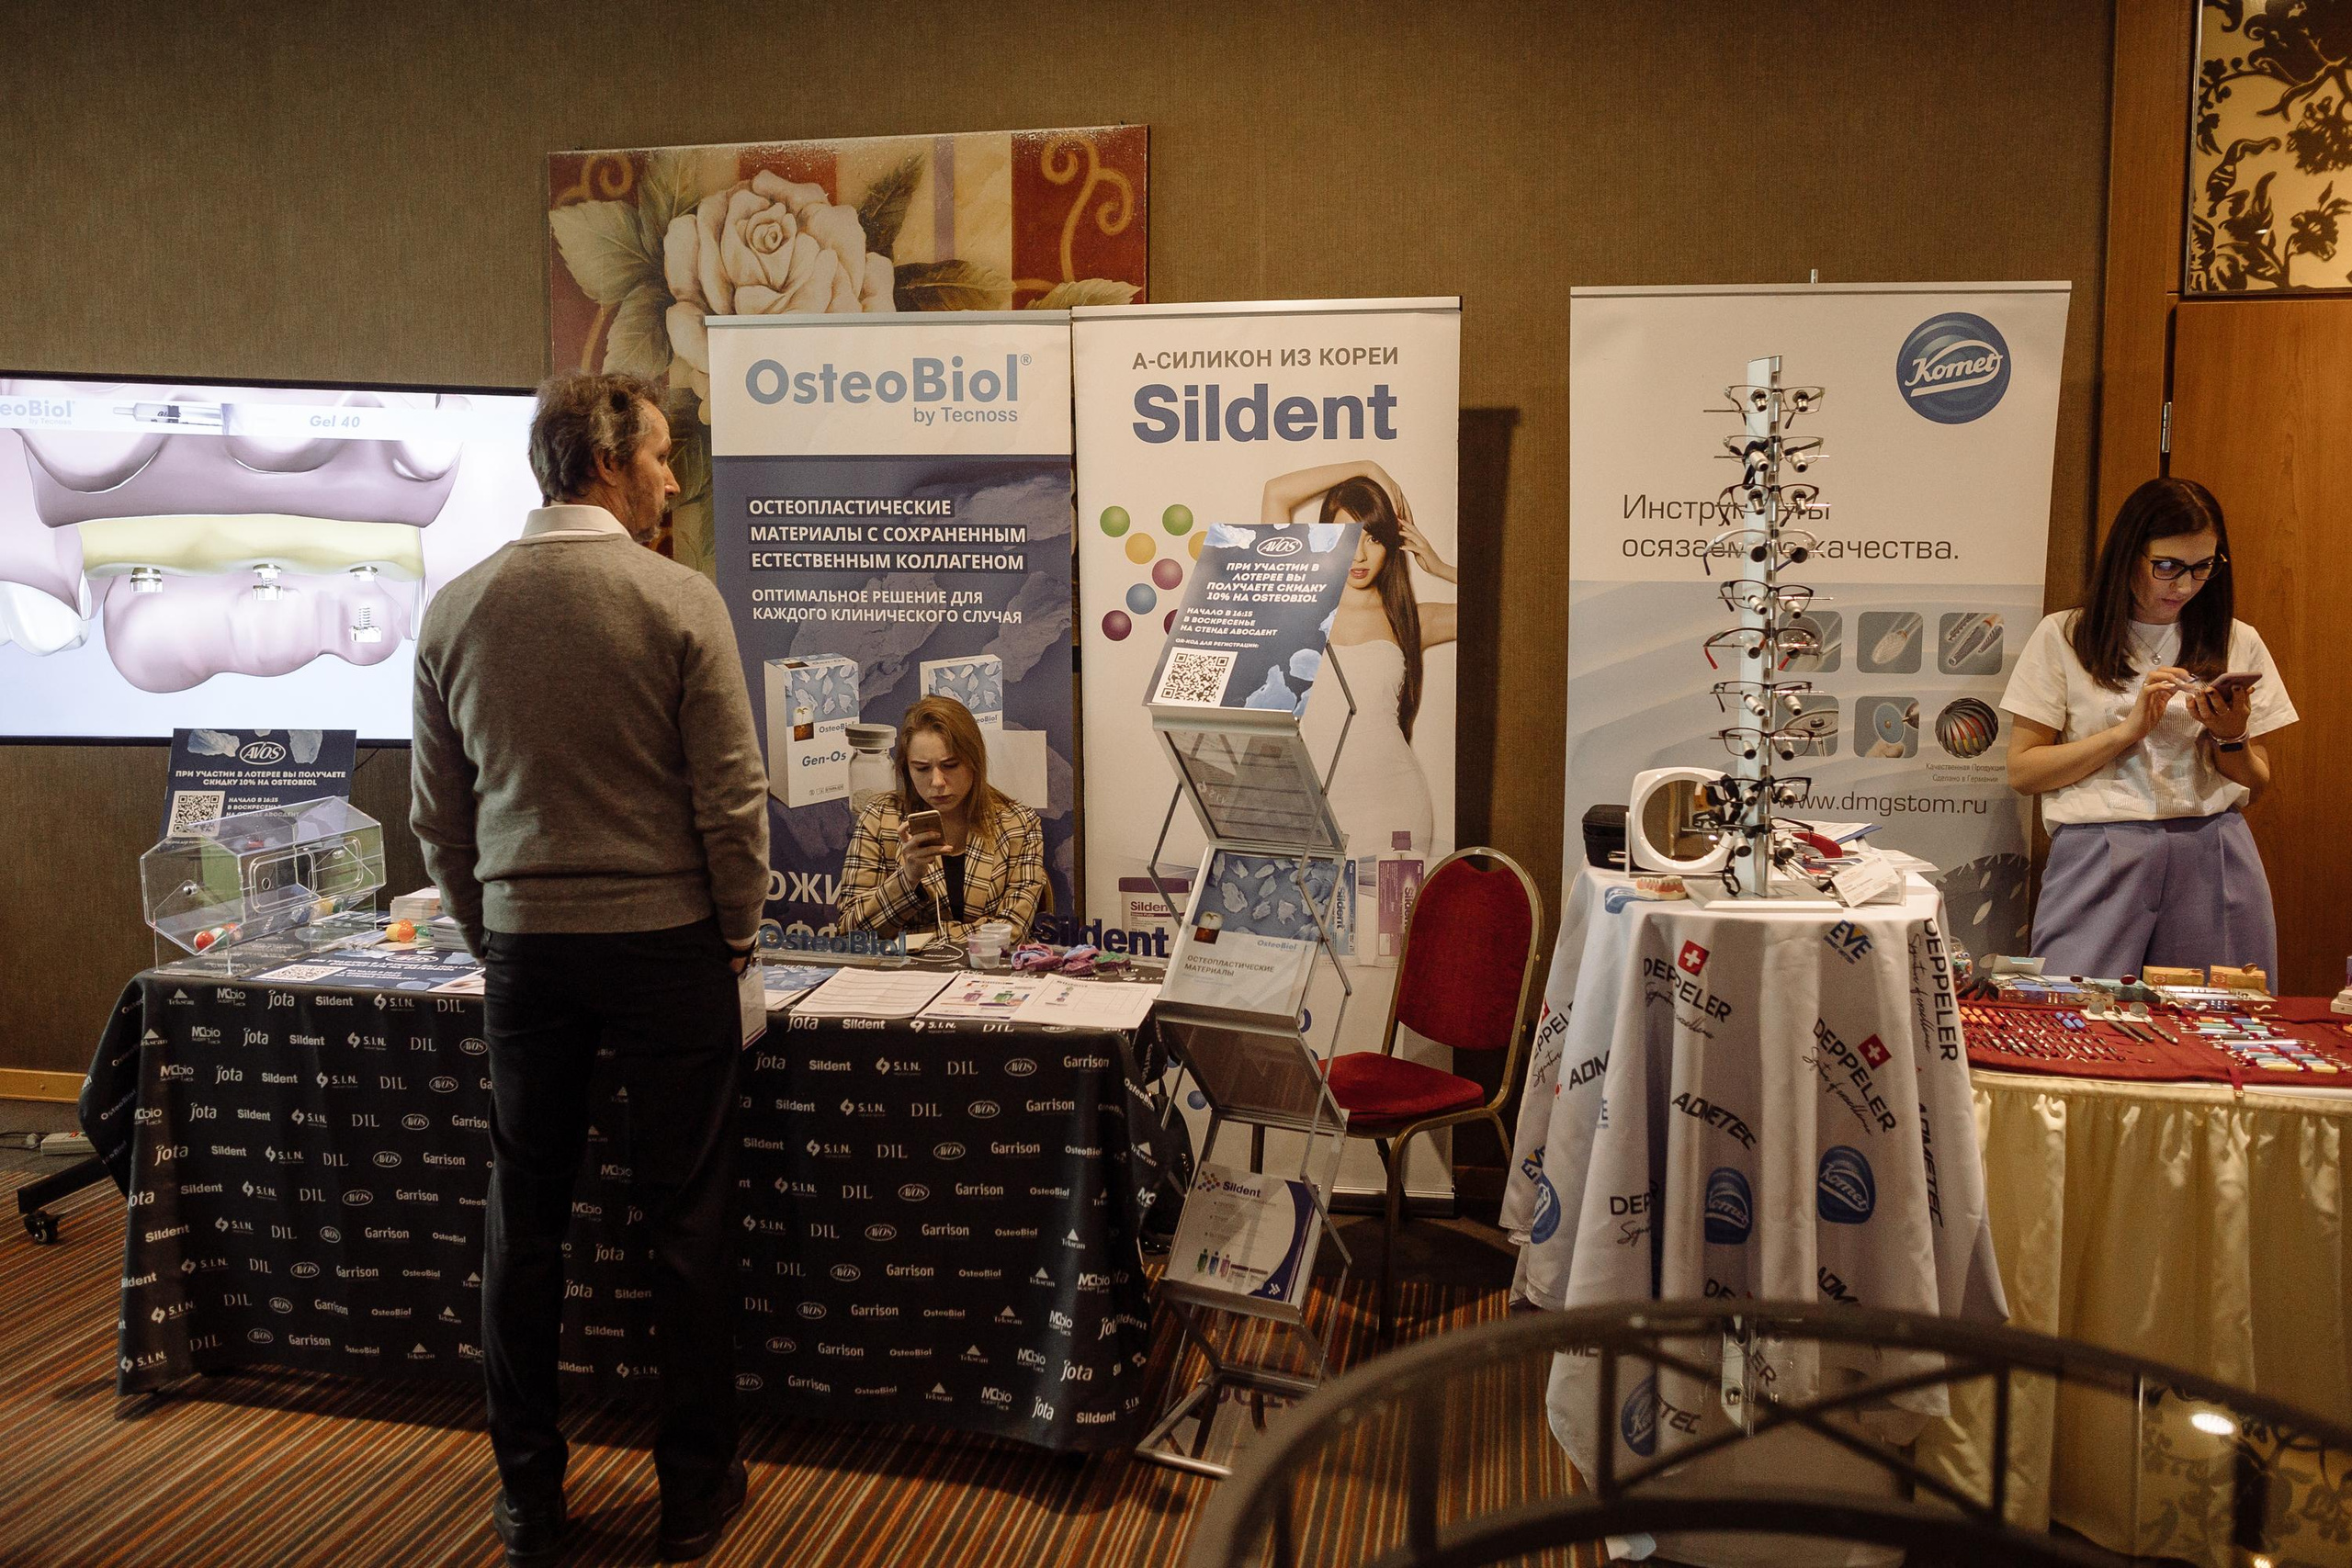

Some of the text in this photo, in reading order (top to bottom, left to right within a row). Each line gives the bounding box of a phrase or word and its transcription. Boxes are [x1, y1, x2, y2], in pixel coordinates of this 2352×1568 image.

[1133, 347, 1398, 370] А-СИЛИКОН ИЗ КОРЕИ
[1904, 340, 2003, 387] Komet
[913, 407, 1017, 426] by Tecnoss
[1133, 383, 1397, 444] Sildent
[310, 415, 360, 428] Gel 40
[750, 501, 951, 515] ОСТЕОПЛАСТИЧЕСКИЕ
[751, 526, 1025, 543] МАТЕРИАЛЫ С СОХРАНЕННЫМ
[1811, 540, 1959, 559] качества.
[752, 553, 1023, 570] ЕСТЕСТВЕННЫМ КОЛЛАГЕНОМ
[1254, 563, 1308, 571] УЧАСТИИ
[1232, 573, 1283, 581] ЛОТЕРЕЕ
[1206, 582, 1327, 592] ПОЛУЧАЕТЕ СКИДКУ
[752, 590, 982, 606] ОПТИМАЛЬНОЕ РЕШЕНИЕ ДЛЯ
[1206, 592, 1317, 603] 10% НА OSTEOBIOL
[752, 607, 1022, 624] КАЖДОГО КЛИНИЧЕСКОГО СЛУЧАЯ
[1192, 617, 1255, 626] ВОСКРЕСЕНЬЕ
[802, 751, 846, 767] Gen-Os
[759, 924, 906, 957] OsteoBiol
[1034, 911, 1170, 958] Sildent
[1830, 919, 1872, 960] EVE
[1184, 964, 1235, 976] МАТЕРИАЛЫ
[1187, 955, 1274, 973] ОСТЕОПЛАСТИЧЕСКИЕ
[1923, 918, 1958, 1061] DEPPELER
[316, 997, 353, 1006] Sildent
[437, 999, 465, 1012] DIL
[842, 1019, 885, 1030] Sildent
[289, 1035, 324, 1045] Sildent
[411, 1038, 436, 1051] DIL
[808, 1060, 852, 1071] Sildent
[1063, 1055, 1110, 1068] Garrison
[262, 1073, 298, 1084] Sildent
[1814, 1017, 1896, 1133] DEPPELER
[380, 1077, 407, 1089] DIL
[775, 1100, 816, 1111] Sildent
[1026, 1099, 1075, 1112] Garrison
[238, 1110, 271, 1121] Sildent
[743, 1138, 784, 1150] Sildent
[991, 1142, 1040, 1155] Garrison
[211, 1146, 246, 1156] Sildent
[877, 1145, 908, 1158] DIL
[323, 1153, 348, 1166] DIL
[424, 1152, 466, 1166] Garrison
[181, 1183, 222, 1194] Sildent
[842, 1185, 873, 1199] DIL
[956, 1182, 1004, 1195] Garrison
[1222, 1181, 1261, 1198] Sildent
[300, 1189, 326, 1202] DIL
[396, 1190, 438, 1201] Garrison
[145, 1224, 190, 1243] Sildent
[365, 1227, 409, 1239] Garrison
[250, 1258, 272, 1273] DIL
[777, 1262, 806, 1276] DIL
[886, 1264, 934, 1276] Garrison
[224, 1294, 252, 1306] DIL
[744, 1297, 774, 1312] DIL
[314, 1299, 348, 1315] Garrison
[851, 1304, 899, 1316] Garrison
[190, 1335, 222, 1351] DIL
[288, 1335, 332, 1347] Garrison
[818, 1342, 864, 1357] Garrison
[1076, 1411, 1116, 1424] Sildent
